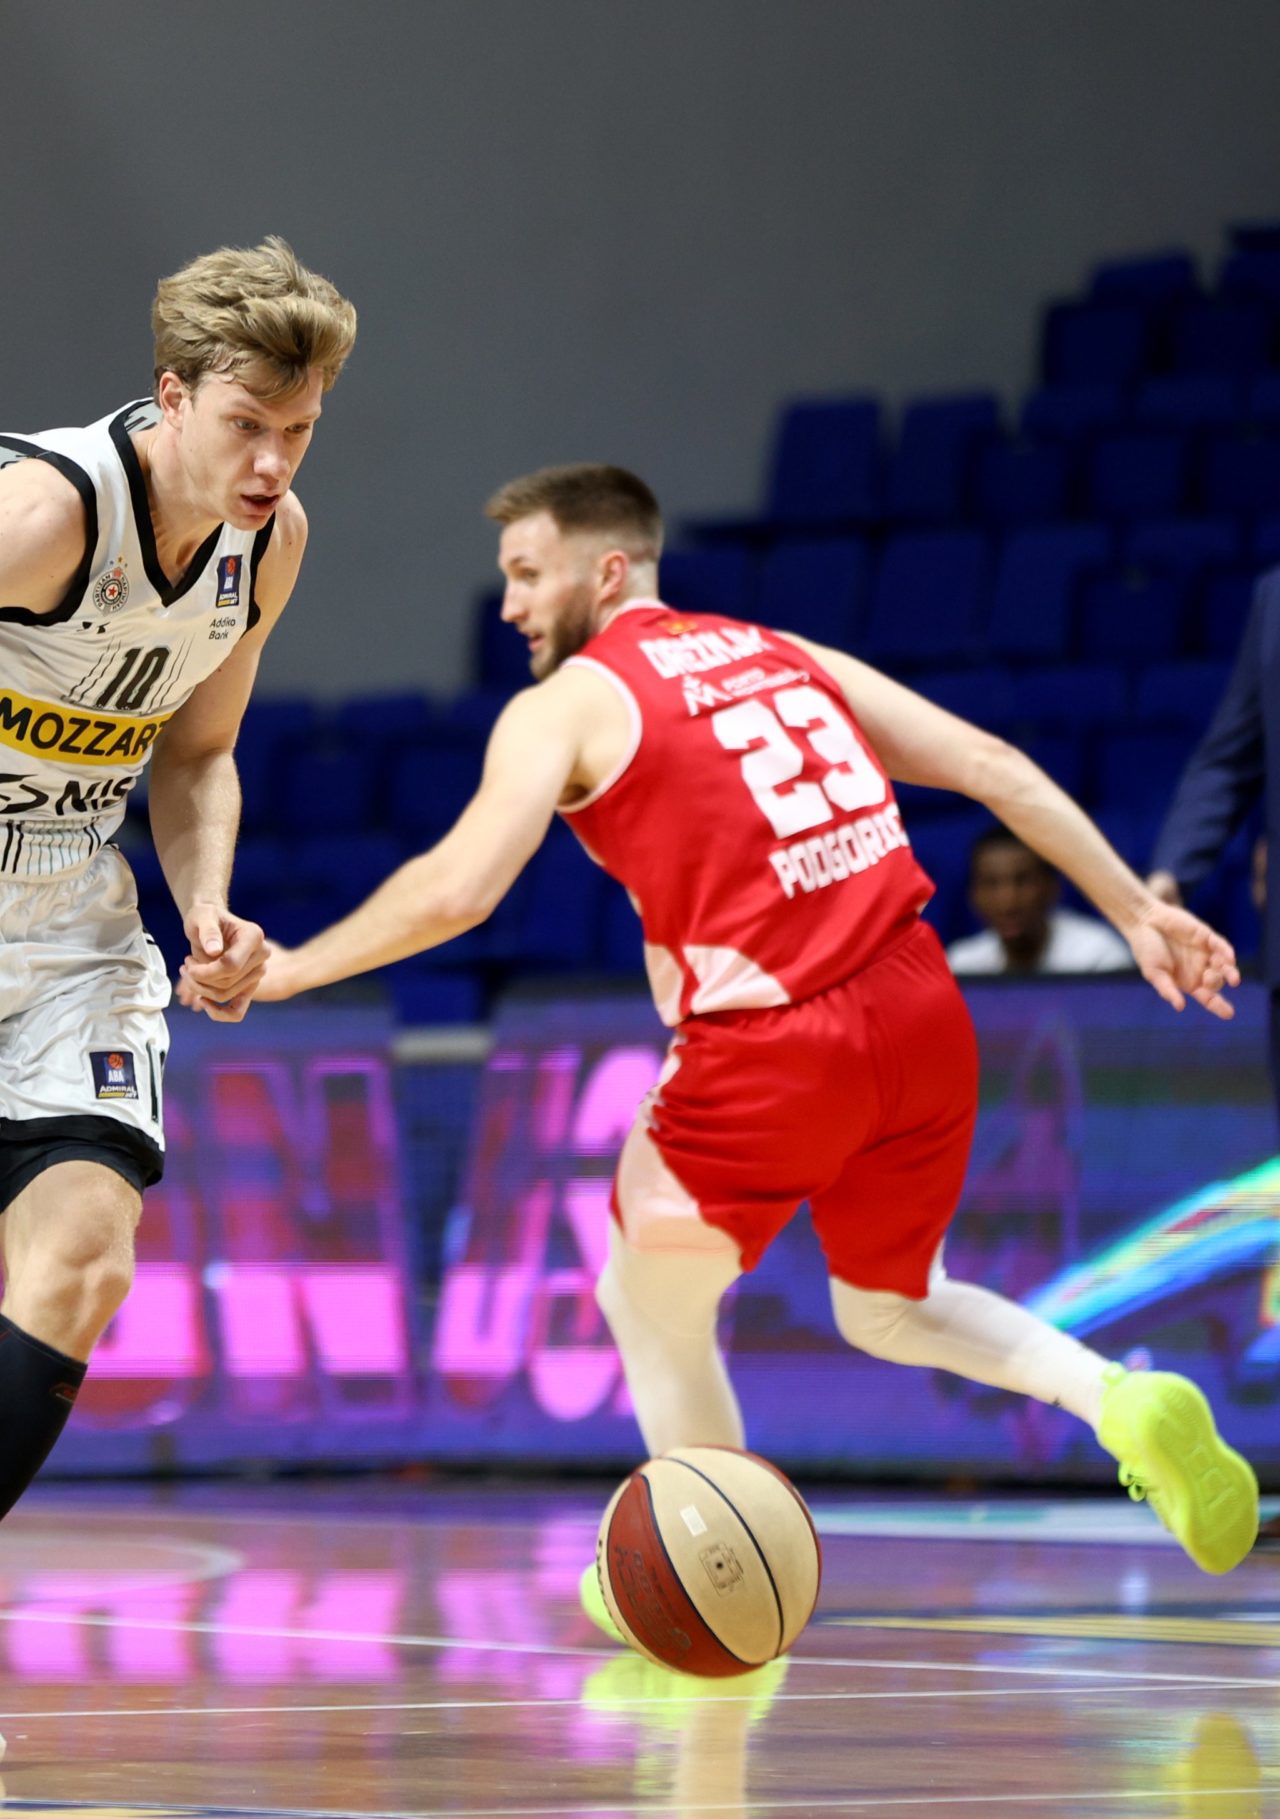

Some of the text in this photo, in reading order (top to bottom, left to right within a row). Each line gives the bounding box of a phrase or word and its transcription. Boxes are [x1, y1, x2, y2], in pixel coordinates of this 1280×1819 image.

[208, 630, 229, 640] Bank
[209, 617, 236, 628] Addiko
[96, 647, 170, 710] 10
[712, 686, 887, 840] 23
[55, 776, 135, 816] NIS
[769, 802, 910, 900] PODGORIC
[99, 1085, 136, 1093] ADMIRAL
